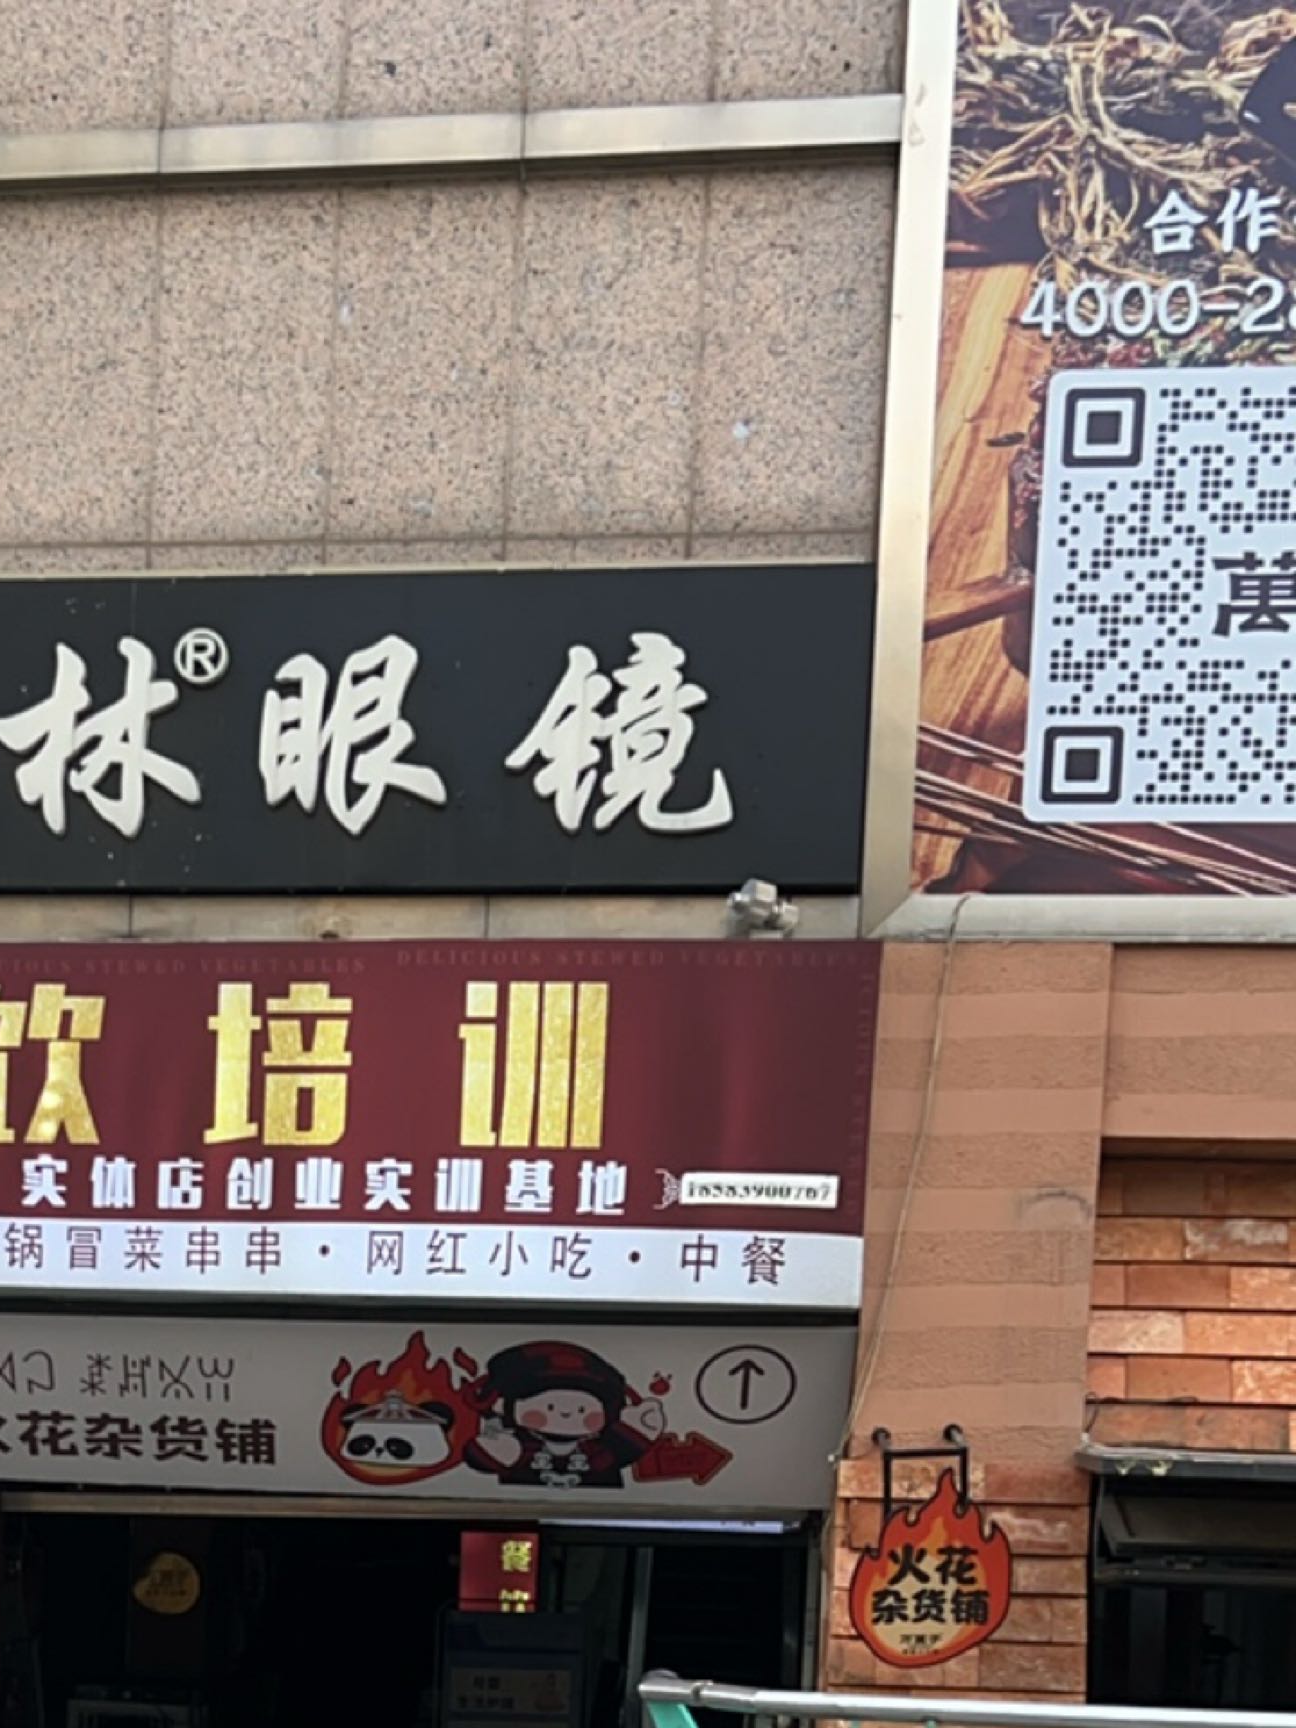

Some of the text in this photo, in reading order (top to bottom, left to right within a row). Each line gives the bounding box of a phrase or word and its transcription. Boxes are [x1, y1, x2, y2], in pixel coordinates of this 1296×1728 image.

[1143, 188, 1296, 253] 合作
[1021, 278, 1296, 337] 4000-2
[21, 1154, 628, 1216] 实体店创业实训基地
[888, 1544, 979, 1585] 火花
[872, 1589, 990, 1625] 杂货铺
